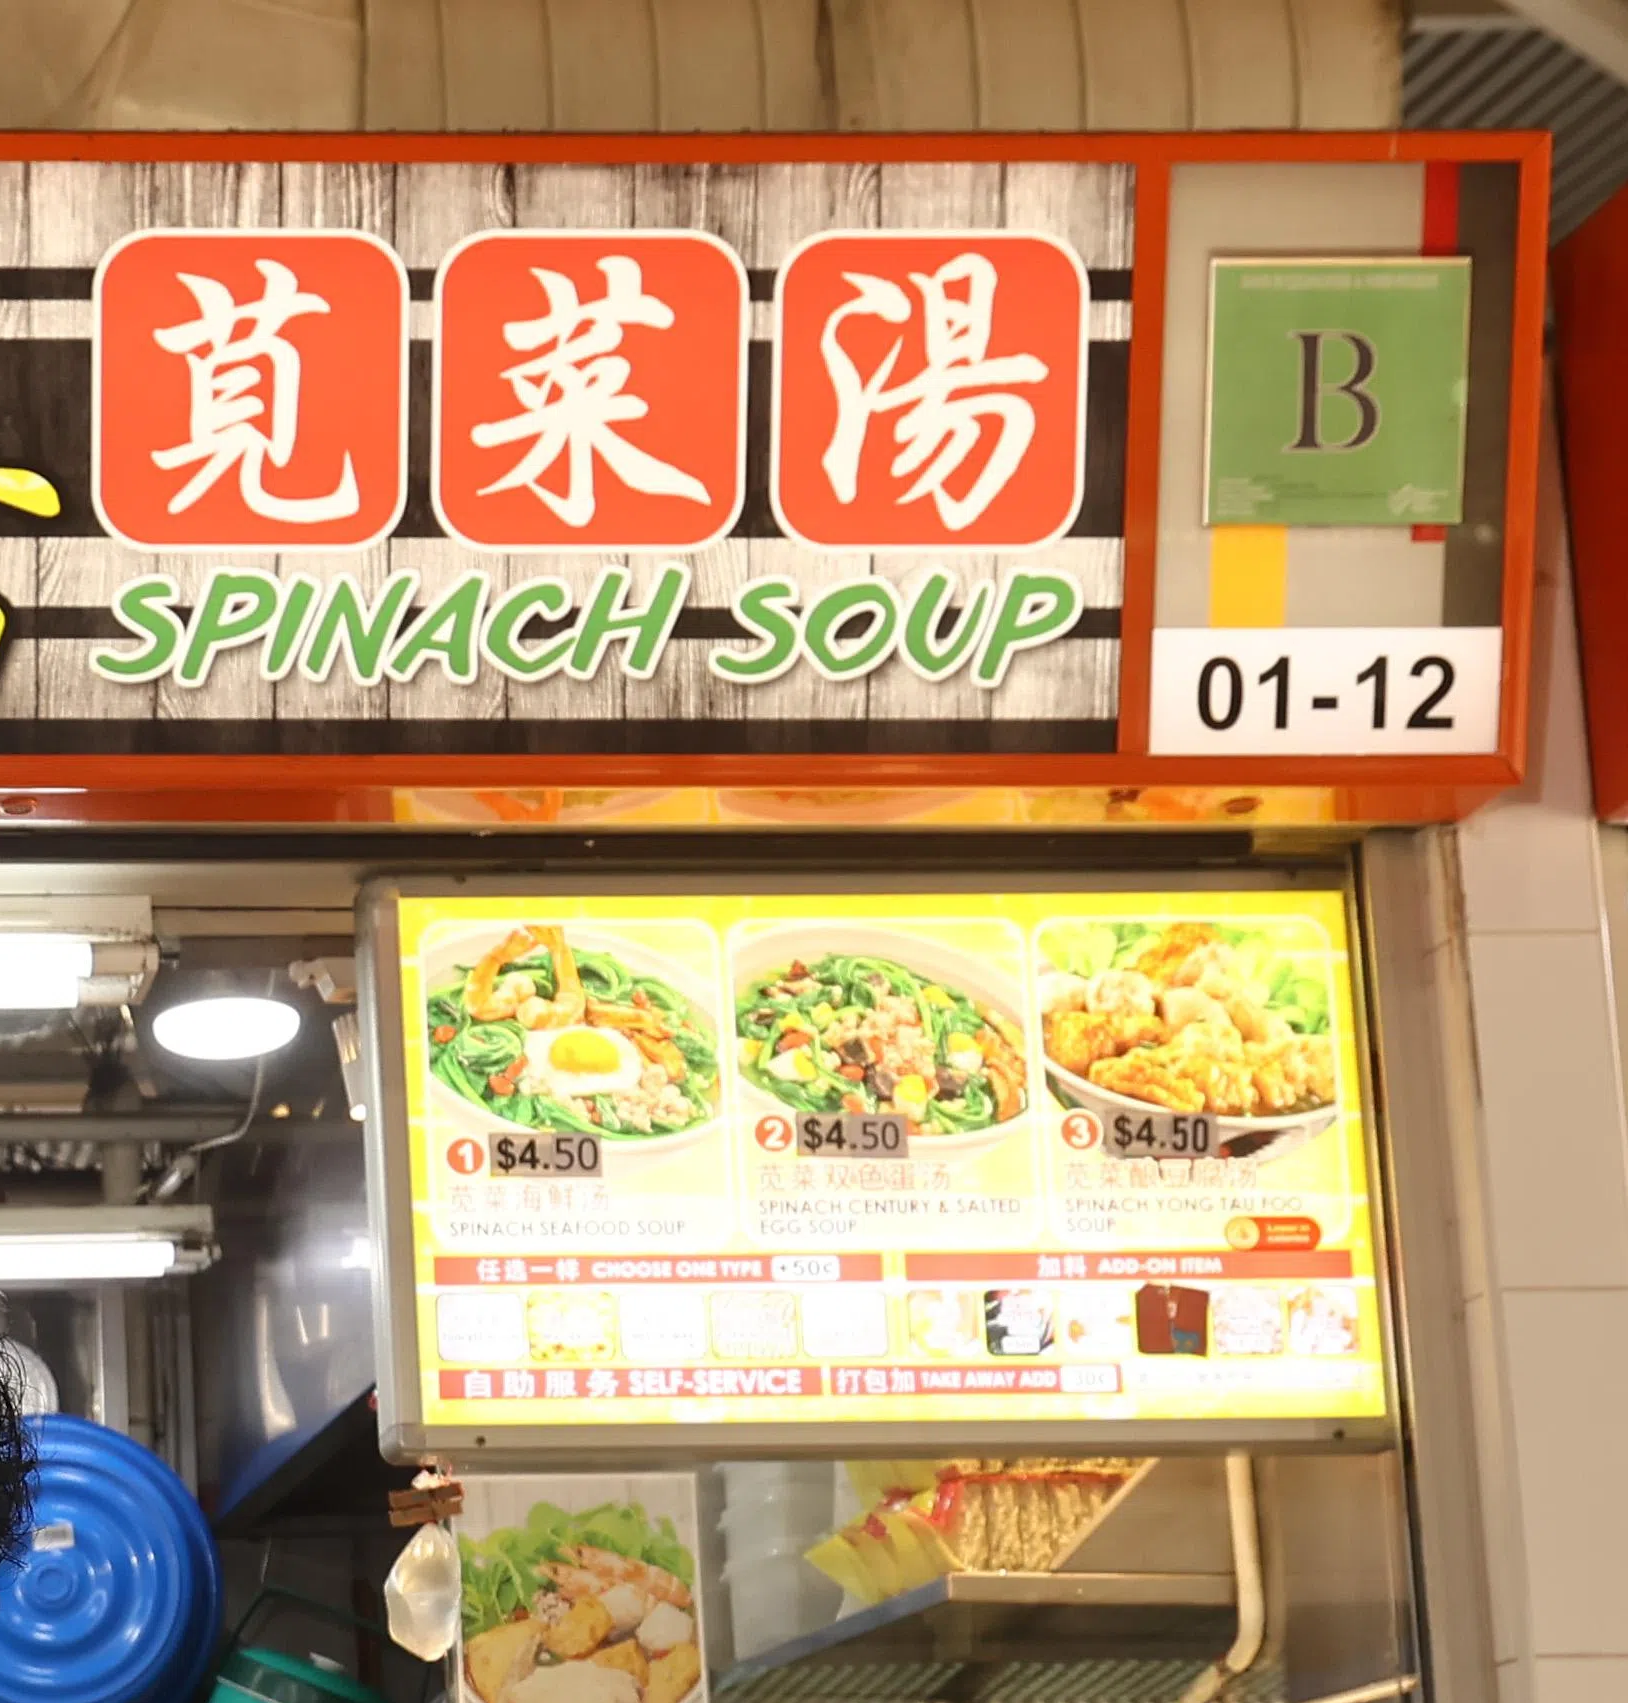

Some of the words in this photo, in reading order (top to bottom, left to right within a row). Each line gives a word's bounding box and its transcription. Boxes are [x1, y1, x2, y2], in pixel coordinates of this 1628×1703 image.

[1281, 329, 1382, 454] B
[94, 568, 684, 684] SPINACH
[712, 568, 1080, 685] SOUP
[1196, 656, 1457, 731] 01-12
[764, 1119, 785, 1148] 2
[803, 1117, 900, 1152] $4.50
[1071, 1117, 1091, 1145] 3
[1113, 1114, 1210, 1152] $4.50
[458, 1144, 475, 1170] 1
[497, 1137, 600, 1173] $4.50
[759, 1199, 842, 1215] SPINACH
[848, 1199, 930, 1214] CENTURY
[938, 1200, 947, 1214] &
[956, 1199, 1021, 1214] SALTED
[1065, 1197, 1149, 1213] SPINACH
[1155, 1197, 1213, 1213] YONG
[1220, 1197, 1255, 1212] TAU
[1261, 1197, 1303, 1212] FOO
[449, 1219, 534, 1237] SPINACH
[539, 1219, 631, 1236] SEAFOOD
[637, 1219, 686, 1236] SOUP
[759, 1219, 802, 1235] EGG
[809, 1219, 857, 1235] SOUP
[1066, 1217, 1116, 1233] SOUP
[590, 1261, 671, 1279] CHOOSE
[676, 1261, 716, 1279] ONE
[720, 1260, 763, 1278] TYPE
[1098, 1256, 1175, 1274] ADD-ON
[1180, 1256, 1223, 1273] ITEM
[463, 1371, 619, 1399] 自助服务
[628, 1370, 803, 1396] SELF-SERVICE
[921, 1371, 962, 1389] TAKE
[965, 1371, 1015, 1388] AWAY
[1019, 1370, 1058, 1388] ADD
